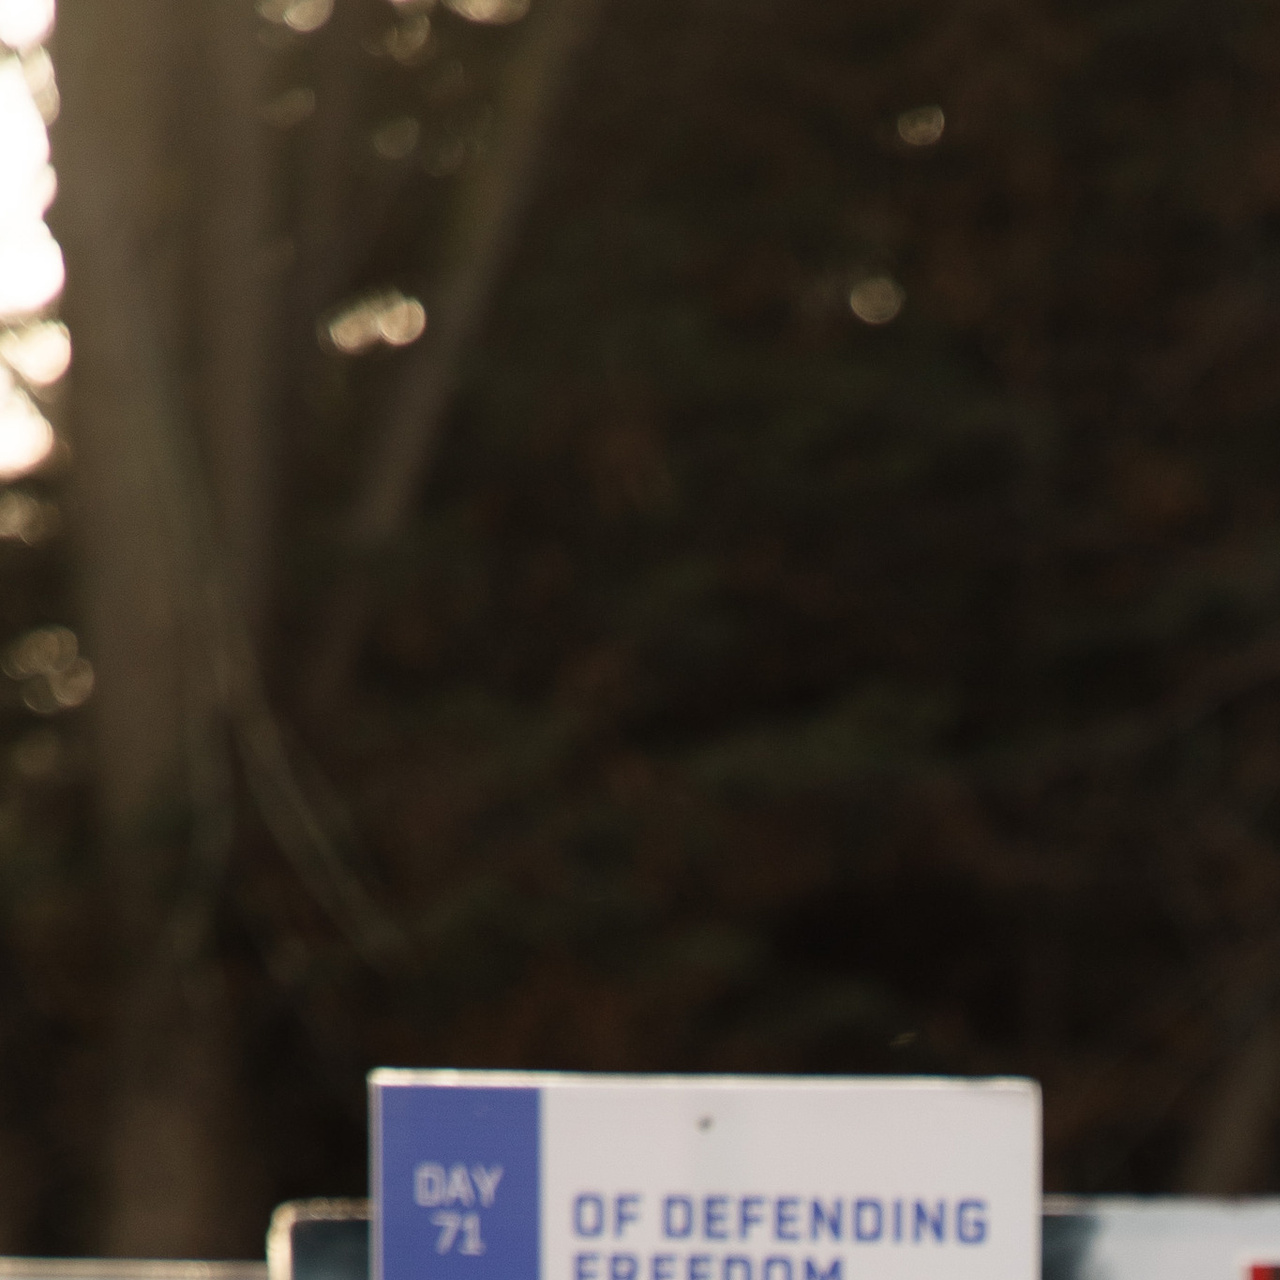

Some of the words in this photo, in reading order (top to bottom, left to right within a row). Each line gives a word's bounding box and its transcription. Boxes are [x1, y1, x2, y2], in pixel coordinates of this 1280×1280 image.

[415, 1163, 502, 1208] DAY
[431, 1215, 485, 1255] 71
[572, 1193, 642, 1239] OF
[662, 1197, 989, 1245] DEFENDING
